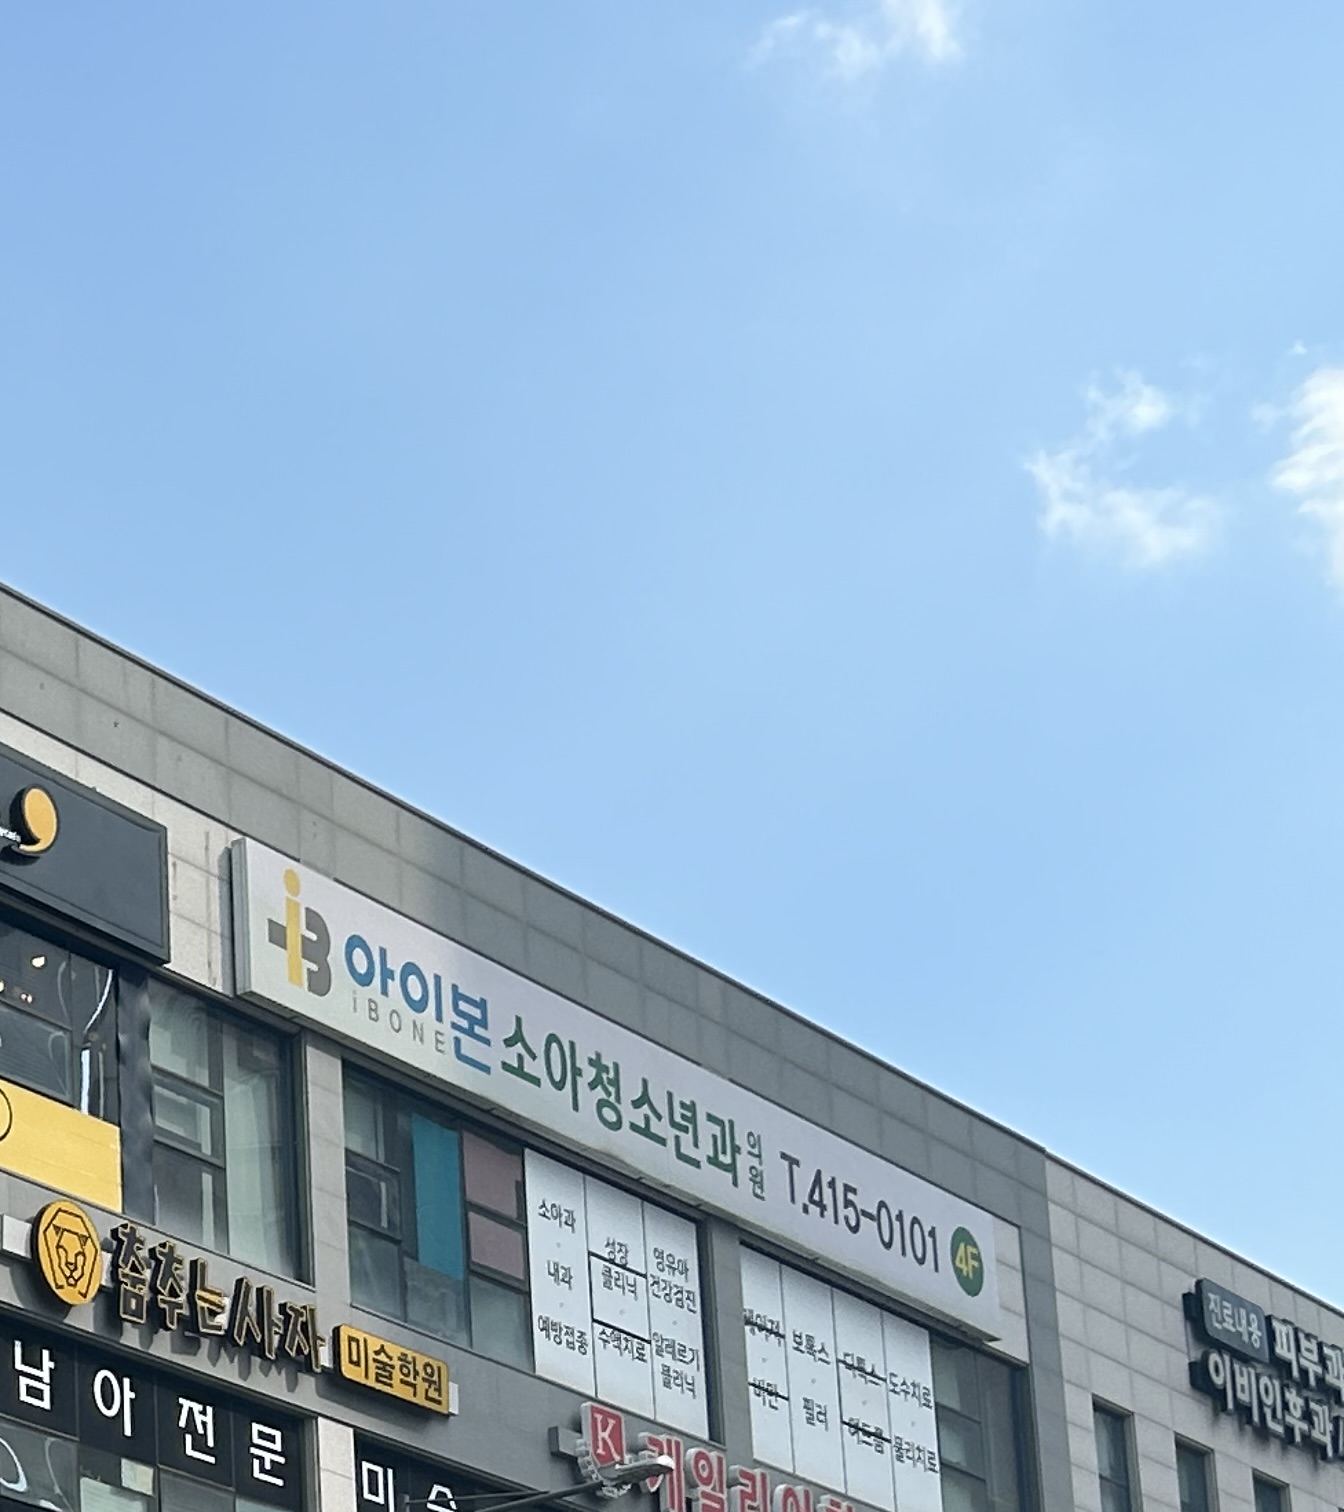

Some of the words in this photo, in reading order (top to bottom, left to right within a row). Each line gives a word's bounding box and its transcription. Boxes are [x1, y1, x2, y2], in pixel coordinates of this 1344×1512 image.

[344, 933, 492, 1075] 아이본
[500, 1015, 742, 1188] 소아청소년과
[746, 1130, 766, 1201] 의원
[538, 1199, 576, 1233] 소아과
[779, 1150, 941, 1275] T.415-0101
[604, 1237, 629, 1267] 성장
[653, 1248, 689, 1283] 영유아
[953, 1241, 981, 1280] 4F
[546, 1260, 574, 1290] 내과
[650, 1274, 697, 1314] 건강검진
[112, 1222, 326, 1373] 춤추는사자
[537, 1315, 588, 1356] 예방접종
[792, 1329, 831, 1365] 보톡스
[346, 1334, 444, 1404] 미술학원
[1271, 1317, 1344, 1403] 피부과
[1207, 1351, 1333, 1459] 이비인후과
